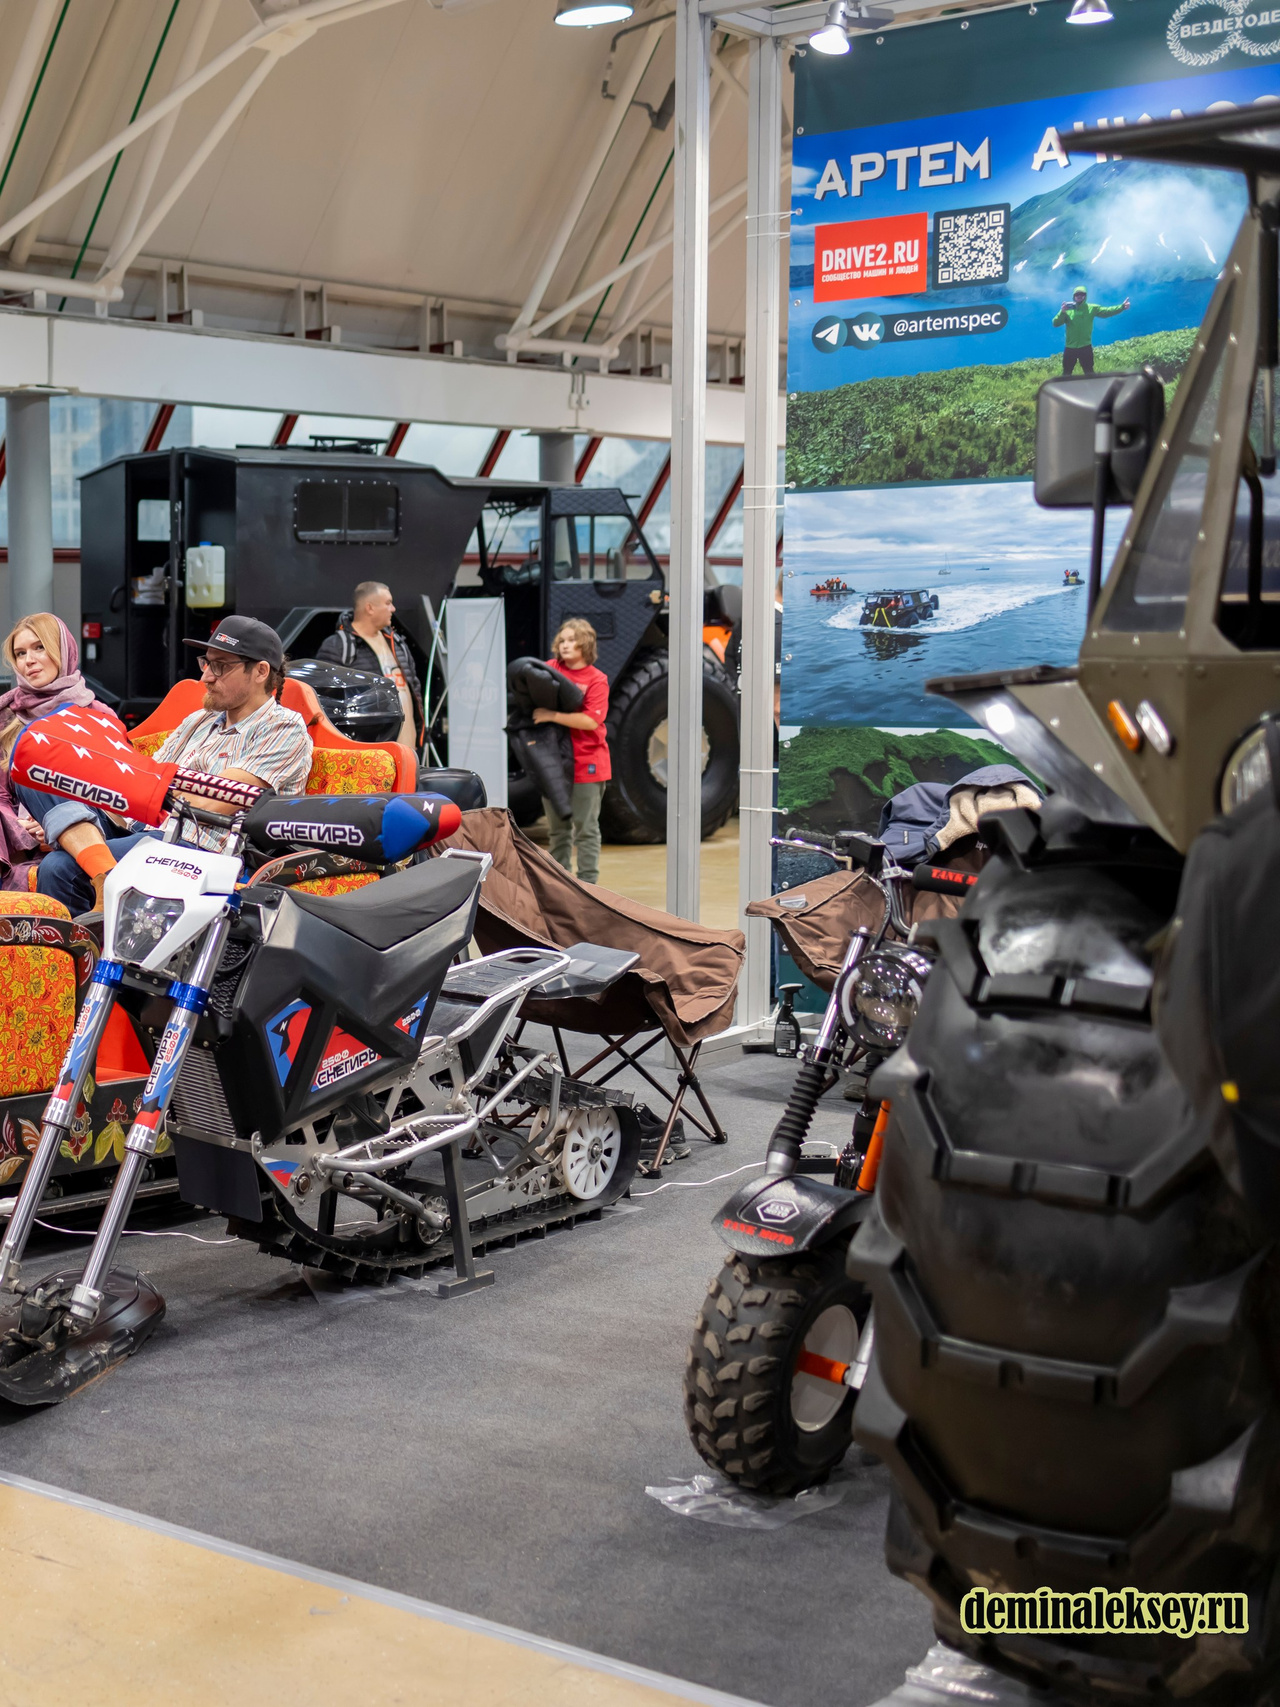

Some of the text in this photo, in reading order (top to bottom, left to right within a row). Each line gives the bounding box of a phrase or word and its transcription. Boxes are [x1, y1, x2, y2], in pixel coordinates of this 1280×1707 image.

[814, 136, 991, 201] АРТЕМ
[821, 239, 919, 272] DRIVE2.RU
[821, 263, 919, 283] СООБЩЕСТВО МАШИН И ЛЮДЕЙ
[893, 311, 1001, 336] @artemspec
[28, 765, 129, 812] СНЕГИРЬ
[267, 822, 364, 845] СНЕГИРЬ
[145, 856, 203, 875] СНЕГИРЬ
[171, 867, 199, 881] 2500
[76, 1006, 91, 1036] 2500
[401, 1008, 421, 1027] 2500
[164, 1032, 180, 1063] 2500
[322, 1049, 349, 1069] 2500
[145, 1029, 173, 1096] СНЕГИРЬ
[316, 1049, 378, 1087] СНЕГИРЬ
